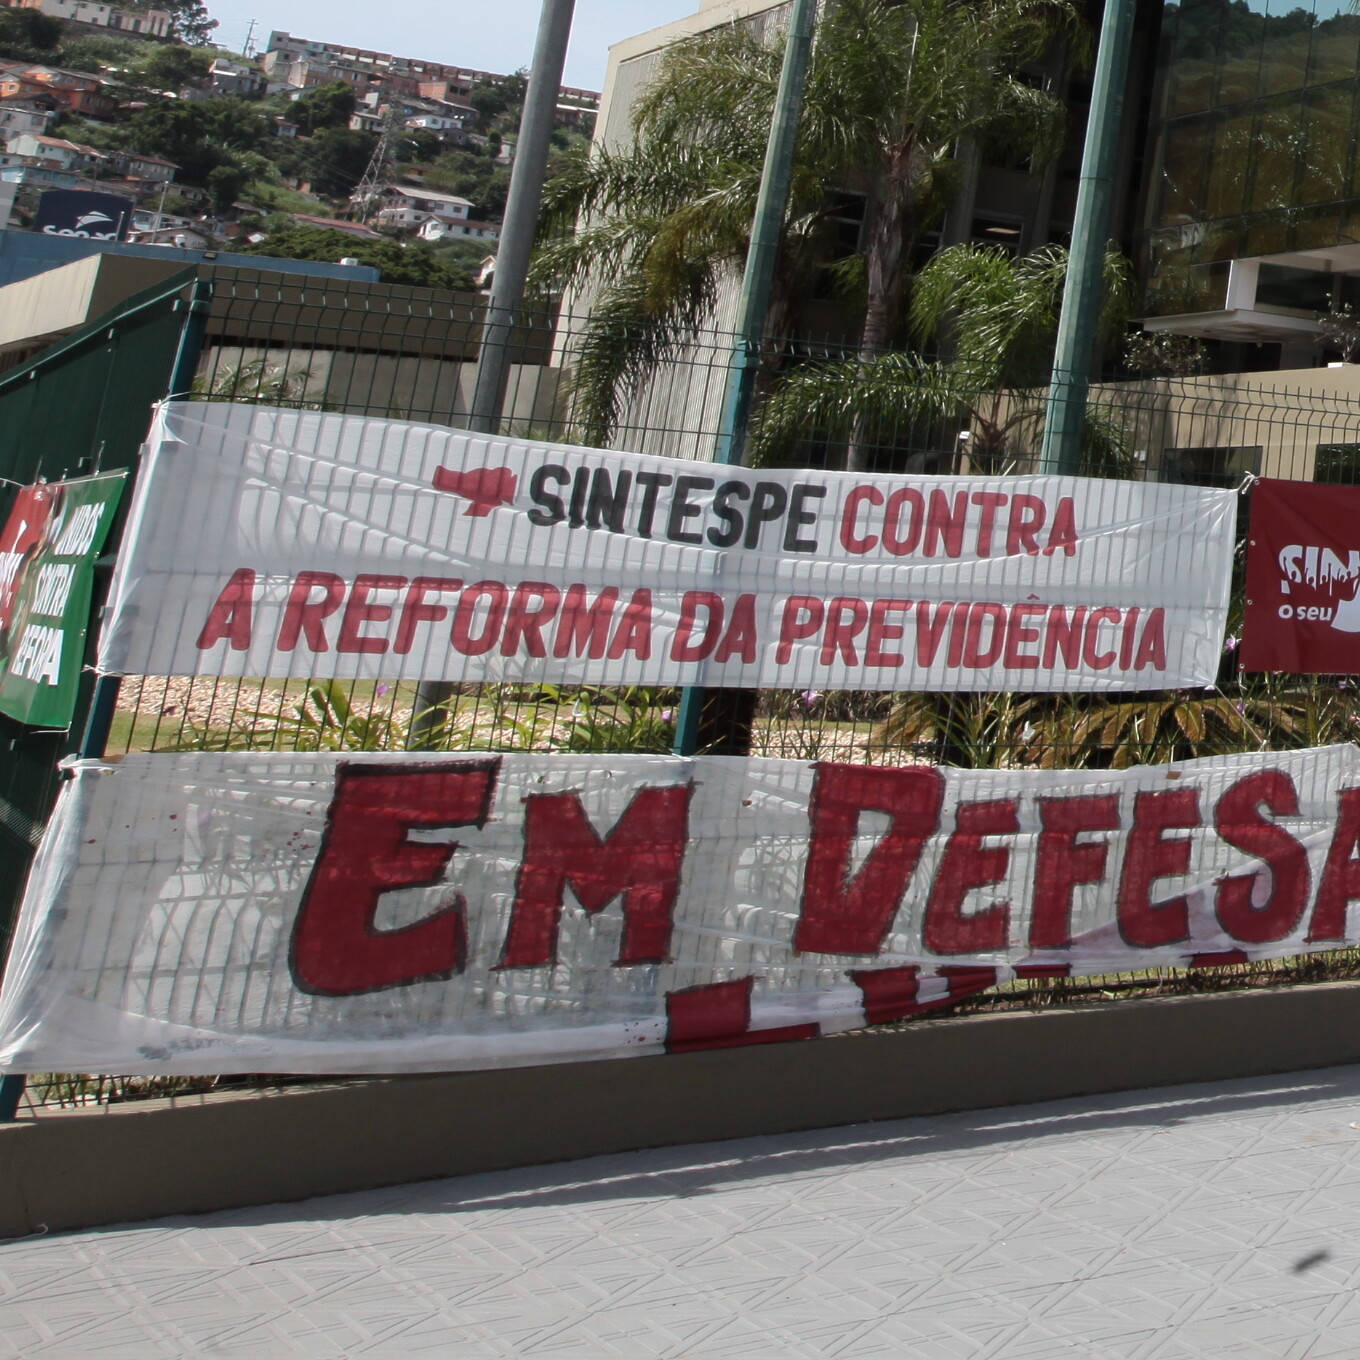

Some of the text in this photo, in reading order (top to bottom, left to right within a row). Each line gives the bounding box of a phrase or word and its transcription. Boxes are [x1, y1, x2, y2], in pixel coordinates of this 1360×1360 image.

[528, 464, 1079, 558] SINTESPE CONTRA
[196, 568, 1166, 671] A REFORMA DA PREVIDÊNCIA
[1278, 604, 1294, 619] o
[1297, 605, 1332, 621] seu
[289, 758, 697, 997] EM
